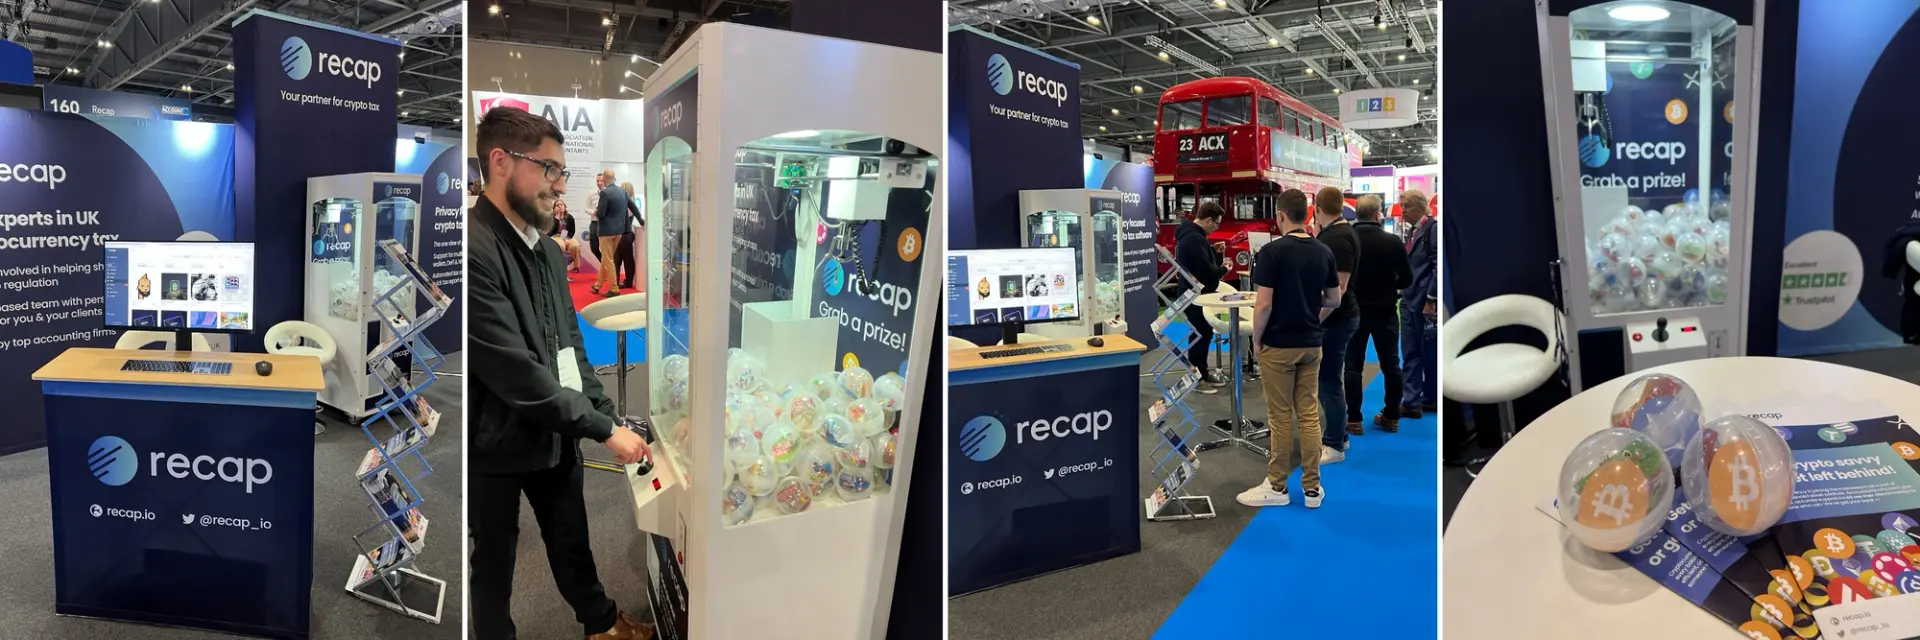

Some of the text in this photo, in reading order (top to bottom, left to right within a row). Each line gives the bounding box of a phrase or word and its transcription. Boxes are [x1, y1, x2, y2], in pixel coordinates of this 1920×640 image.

[318, 52, 381, 88] recap
[1018, 70, 1068, 106] recap
[50, 99, 114, 116] 160 Recap
[280, 90, 380, 112] Your partner for crypto tax
[541, 104, 594, 132] AIA
[661, 101, 682, 130] recap
[990, 104, 1069, 128] Your partner for crypto tax
[1180, 138, 1193, 151] 23
[1199, 135, 1224, 150] ACX
[1616, 142, 1686, 165] recap
[0, 163, 66, 189] ecap
[1580, 172, 1686, 192] Grab a prize!
[394, 186, 411, 196] recap
[0, 209, 100, 231] xperts in UK
[435, 206, 460, 219] Privacy
[434, 220, 455, 234] crypto
[0, 234, 90, 251] ocurrency
[42, 264, 51, 274] in
[54, 263, 90, 275] helping
[4, 278, 58, 291] regulation
[0, 301, 28, 312] ased
[31, 300, 60, 310] team
[61, 296, 82, 306] with
[1796, 296, 1834, 305] Trustpilot
[13, 316, 34, 326] you
[36, 312, 44, 322] &
[46, 311, 69, 323] your
[71, 308, 103, 318] clients
[819, 300, 906, 352] Grab a prize!
[12, 336, 31, 348] top
[33, 330, 91, 344] accounting
[1016, 409, 1113, 444] recap
[1058, 458, 1113, 477] @recap_io
[1836, 456, 1880, 467] savvy
[150, 451, 273, 493] recap
[1808, 471, 1836, 482] left
[1837, 465, 1897, 480] behind!
[977, 475, 1022, 490] recap.io
[106, 506, 156, 522] recap.io
[200, 514, 272, 530] @recap_io
[1681, 520, 1698, 533] or
[1649, 549, 1666, 566] or
[1842, 612, 1871, 621] recap.io
